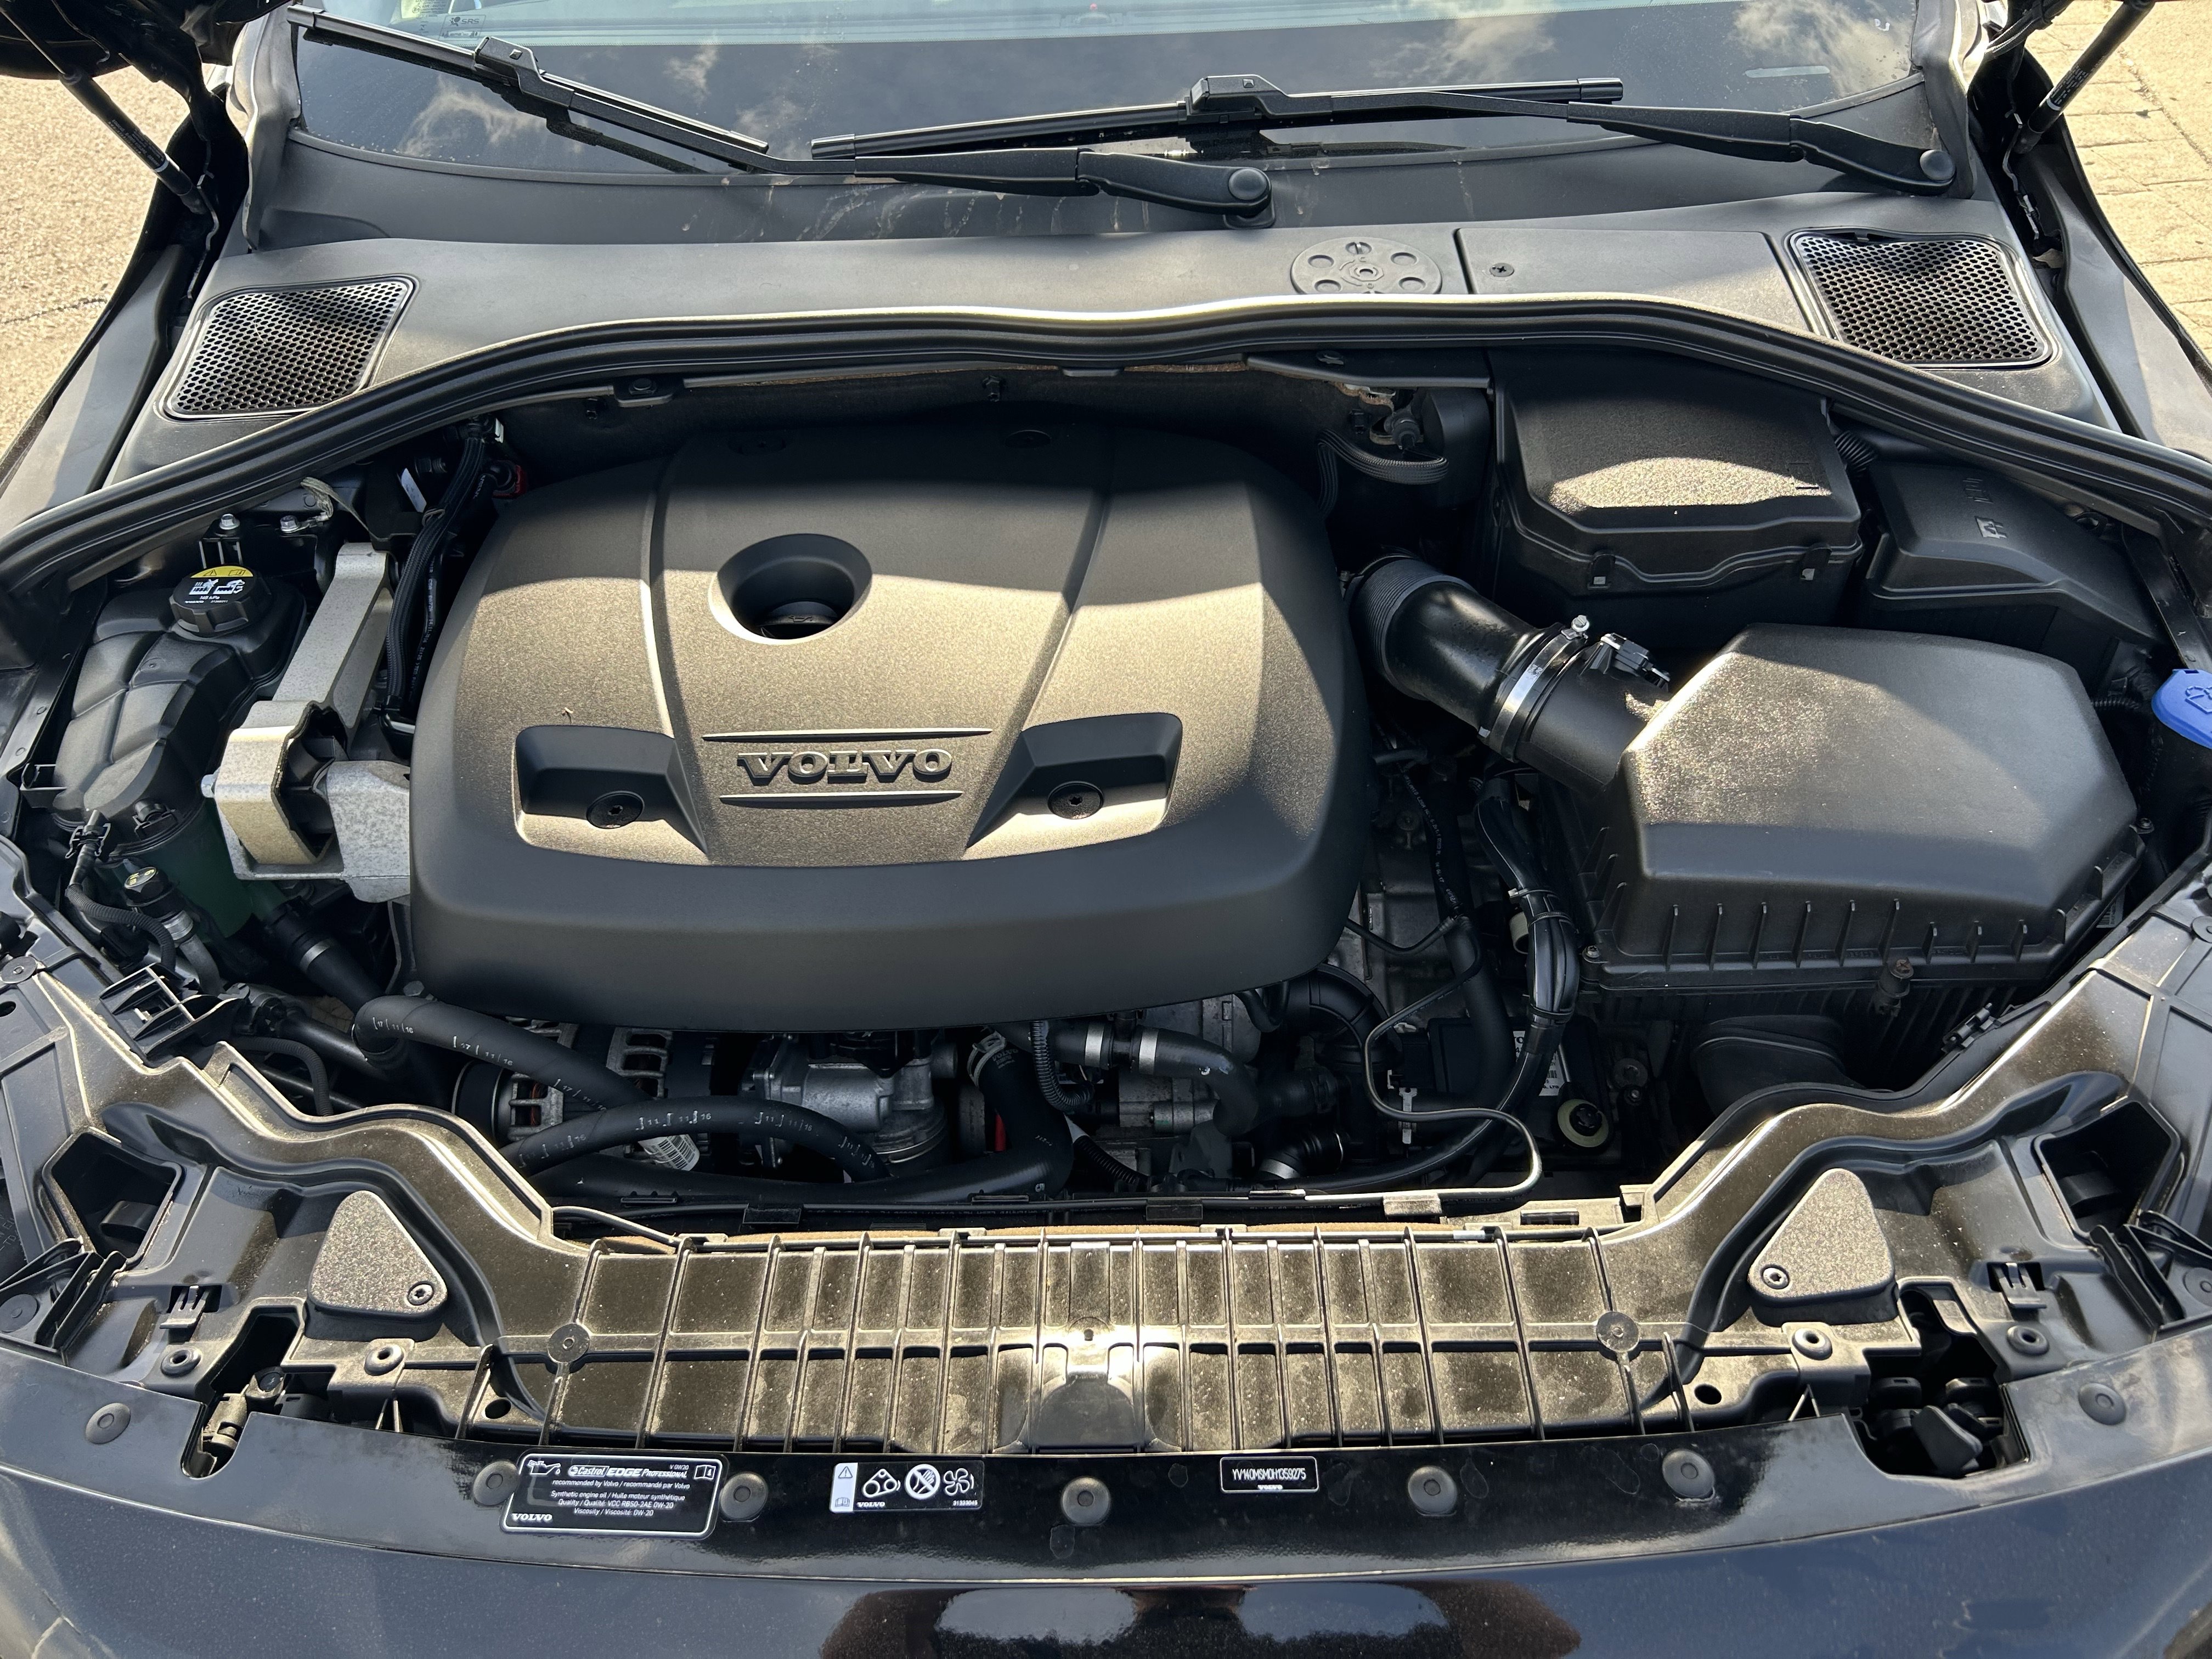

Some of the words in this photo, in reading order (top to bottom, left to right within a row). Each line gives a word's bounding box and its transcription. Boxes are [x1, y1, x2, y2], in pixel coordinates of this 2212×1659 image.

[737, 748, 953, 786] VOLVO
[578, 1466, 605, 1476] Castrol
[606, 1468, 641, 1477] EDGE
[551, 1490, 579, 1498] Synthetic
[651, 1493, 685, 1502] synthétique
[558, 1499, 579, 1507] Quality
[512, 1513, 553, 1522] VOLVO
